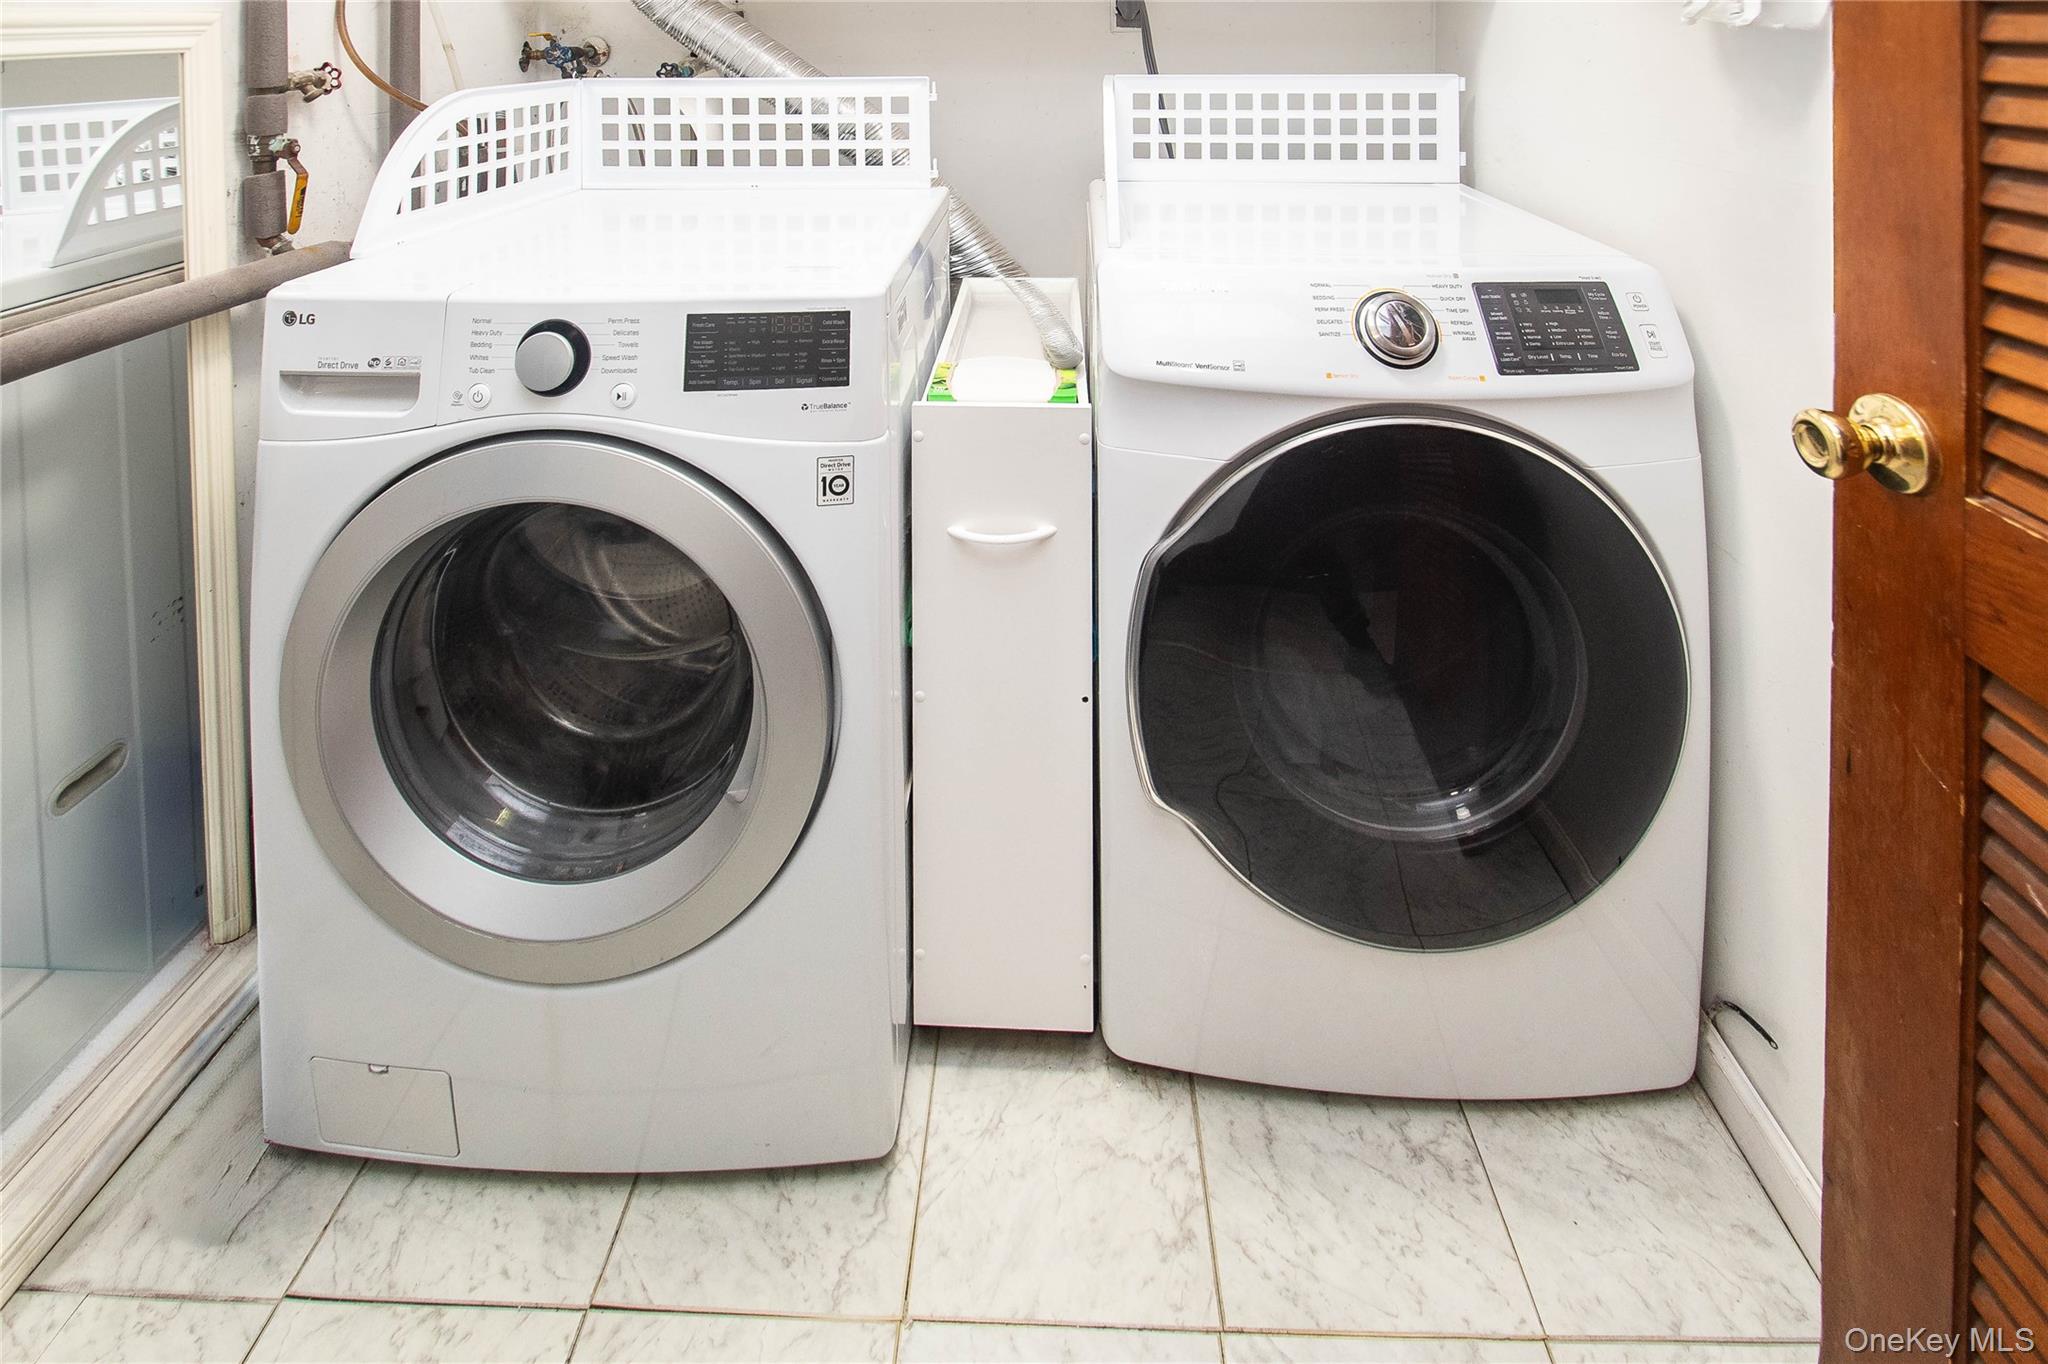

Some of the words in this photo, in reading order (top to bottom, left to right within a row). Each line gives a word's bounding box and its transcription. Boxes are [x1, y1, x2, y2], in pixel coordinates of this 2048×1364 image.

[299, 314, 315, 325] LG
[489, 329, 503, 337] Duty
[470, 341, 492, 349] Bedding
[317, 361, 339, 369] Direct
[340, 361, 359, 370] Drive
[821, 475, 850, 496] 10
